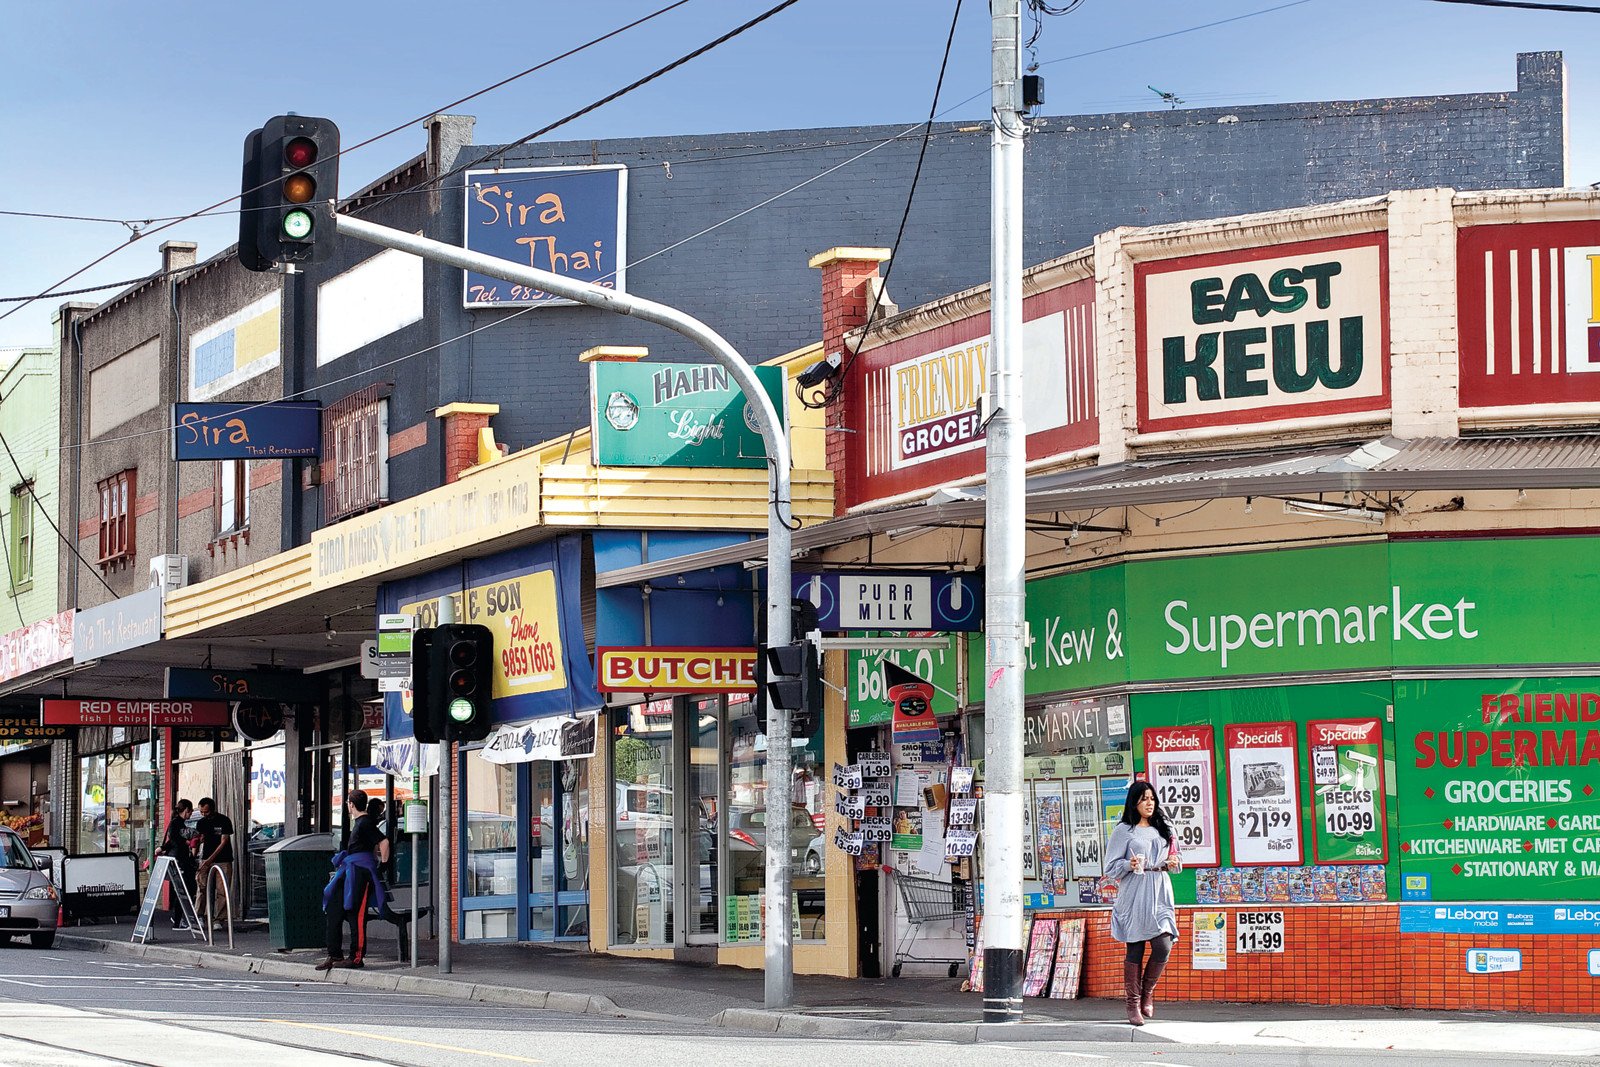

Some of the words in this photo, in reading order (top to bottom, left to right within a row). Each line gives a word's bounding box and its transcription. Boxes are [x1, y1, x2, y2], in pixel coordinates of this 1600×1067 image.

[478, 185, 566, 228] Sira
[515, 235, 603, 274] Thai
[469, 284, 500, 303] Tel.
[1190, 261, 1342, 325] EAST
[1162, 316, 1364, 405] KEW
[652, 364, 730, 407] HAHN
[896, 341, 990, 428] FRIENDLY
[180, 412, 250, 446] Sira
[667, 409, 725, 447] Light
[246, 445, 267, 456] Thai
[268, 445, 315, 456] Restaurant
[348, 524, 379, 567] ANGUS
[859, 584, 913, 601] PURA
[416, 594, 462, 629] OYE
[487, 581, 522, 617] SON
[859, 603, 913, 621] MILK
[97, 617, 114, 647] Thai
[117, 611, 158, 644] Restaurant
[510, 608, 540, 646] Phone
[1163, 586, 1479, 668] Supermarket
[1045, 616, 1095, 668] Kew
[1105, 608, 1124, 660] &
[502, 646, 528, 678] 9859
[528, 641, 556, 674] 1603
[212, 674, 249, 694] Sira
[80, 701, 111, 714] RED
[117, 701, 193, 714] EMPEROR
[850, 709, 860, 722] 655
[1481, 693, 1600, 723] FRIEND
[80, 713, 102, 723] fish
[118, 714, 147, 725] chips
[164, 714, 194, 723] sushi
[24, 727, 66, 736] SHOP
[1236, 730, 1283, 748] Specials
[1319, 728, 1367, 744] Specials
[1156, 734, 1200, 752] Specials
[858, 752, 890, 761] CARLSBERG
[1316, 753, 1334, 766] Corona
[1158, 765, 1179, 777] CROWN
[1180, 764, 1200, 776] LAGER
[1316, 768, 1336, 778] $49.99
[833, 775, 860, 789] 12-99
[840, 793, 859, 805] VB
[1159, 785, 1200, 803] 12-99
[1326, 790, 1371, 804] BECKS
[1445, 779, 1572, 804] GROCERIES
[865, 795, 890, 806] 2-99
[836, 803, 863, 819] 10-99
[951, 812, 973, 825] 13-99
[1164, 805, 1195, 819] VB
[860, 817, 891, 825] BECKS
[1239, 811, 1291, 837] $21.99
[1327, 811, 1372, 832] 10-99
[1454, 815, 1546, 832] HARDWARE
[837, 825, 863, 841] CORONA
[861, 829, 891, 841] 10-99
[834, 836, 860, 855] 13-99
[947, 843, 973, 855] 10-99
[1076, 839, 1099, 864] $2.49
[1410, 838, 1522, 855] KITCHENWARE
[1534, 838, 1567, 854] MET
[1463, 861, 1559, 877] STATIONARY
[1564, 861, 1576, 877] &
[1239, 912, 1282, 925] BECKS
[1447, 908, 1498, 920] Lebara
[1239, 932, 1282, 949] 11-99
[1489, 955, 1514, 964] Prepaid
